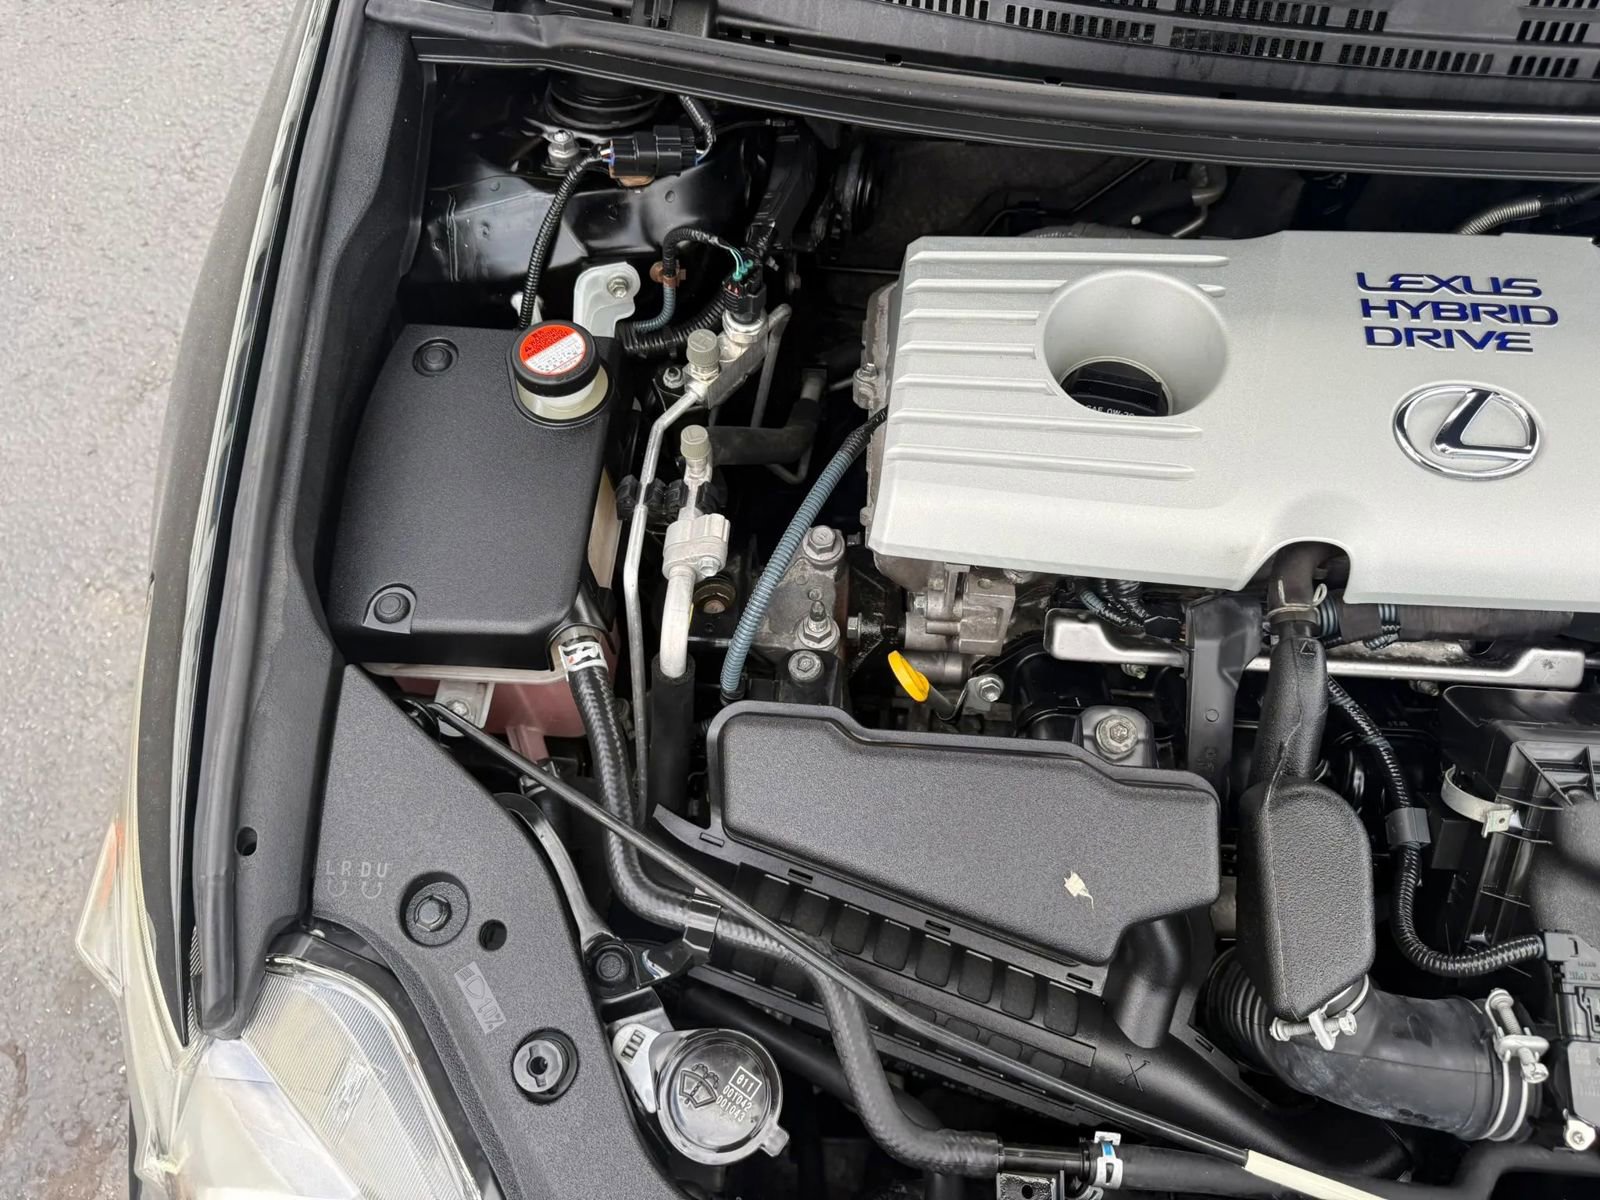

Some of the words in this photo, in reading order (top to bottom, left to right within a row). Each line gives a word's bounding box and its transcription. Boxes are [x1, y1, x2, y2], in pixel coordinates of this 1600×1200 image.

[1356, 272, 1542, 298] LEXUS
[1360, 298, 1559, 327] HYBRID
[1364, 326, 1534, 353] DRIVE
[715, 1095, 746, 1122] 001043
[723, 1085, 753, 1112] 001042
